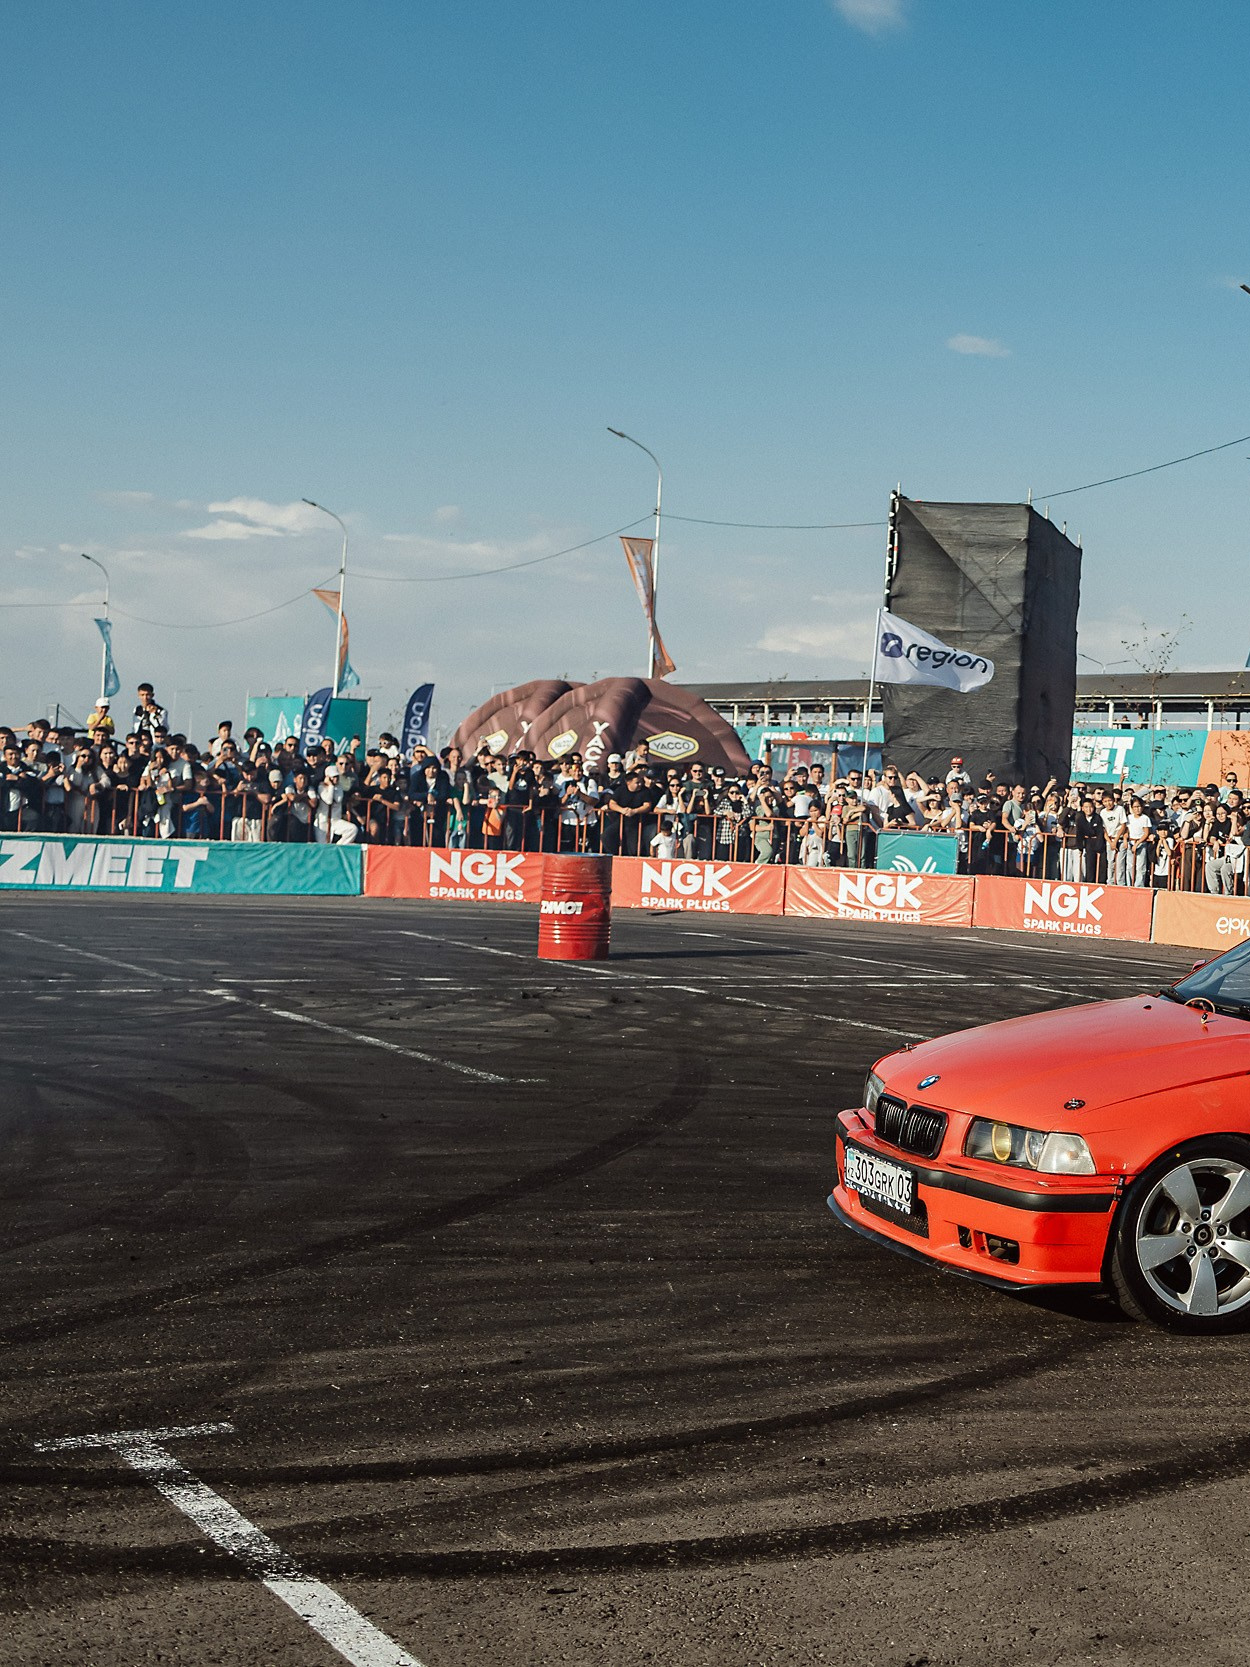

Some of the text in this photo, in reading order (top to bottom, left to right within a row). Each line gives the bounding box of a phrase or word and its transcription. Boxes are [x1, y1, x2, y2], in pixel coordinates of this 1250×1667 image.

[904, 643, 988, 674] region
[302, 703, 324, 757] gion
[404, 701, 427, 761] egion
[653, 742, 691, 751] YACCO
[429, 850, 526, 887] NGK
[641, 861, 732, 898] NGK
[429, 886, 524, 900] SPARK PLUGS
[641, 896, 730, 911] SPARK PLUGS
[838, 872, 924, 910] NGK
[1023, 881, 1105, 921] NGK
[838, 908, 921, 922] SPARK PLUGS
[1023, 918, 1102, 935] SPARK PLUGS
[897, 1173, 911, 1203] 03
